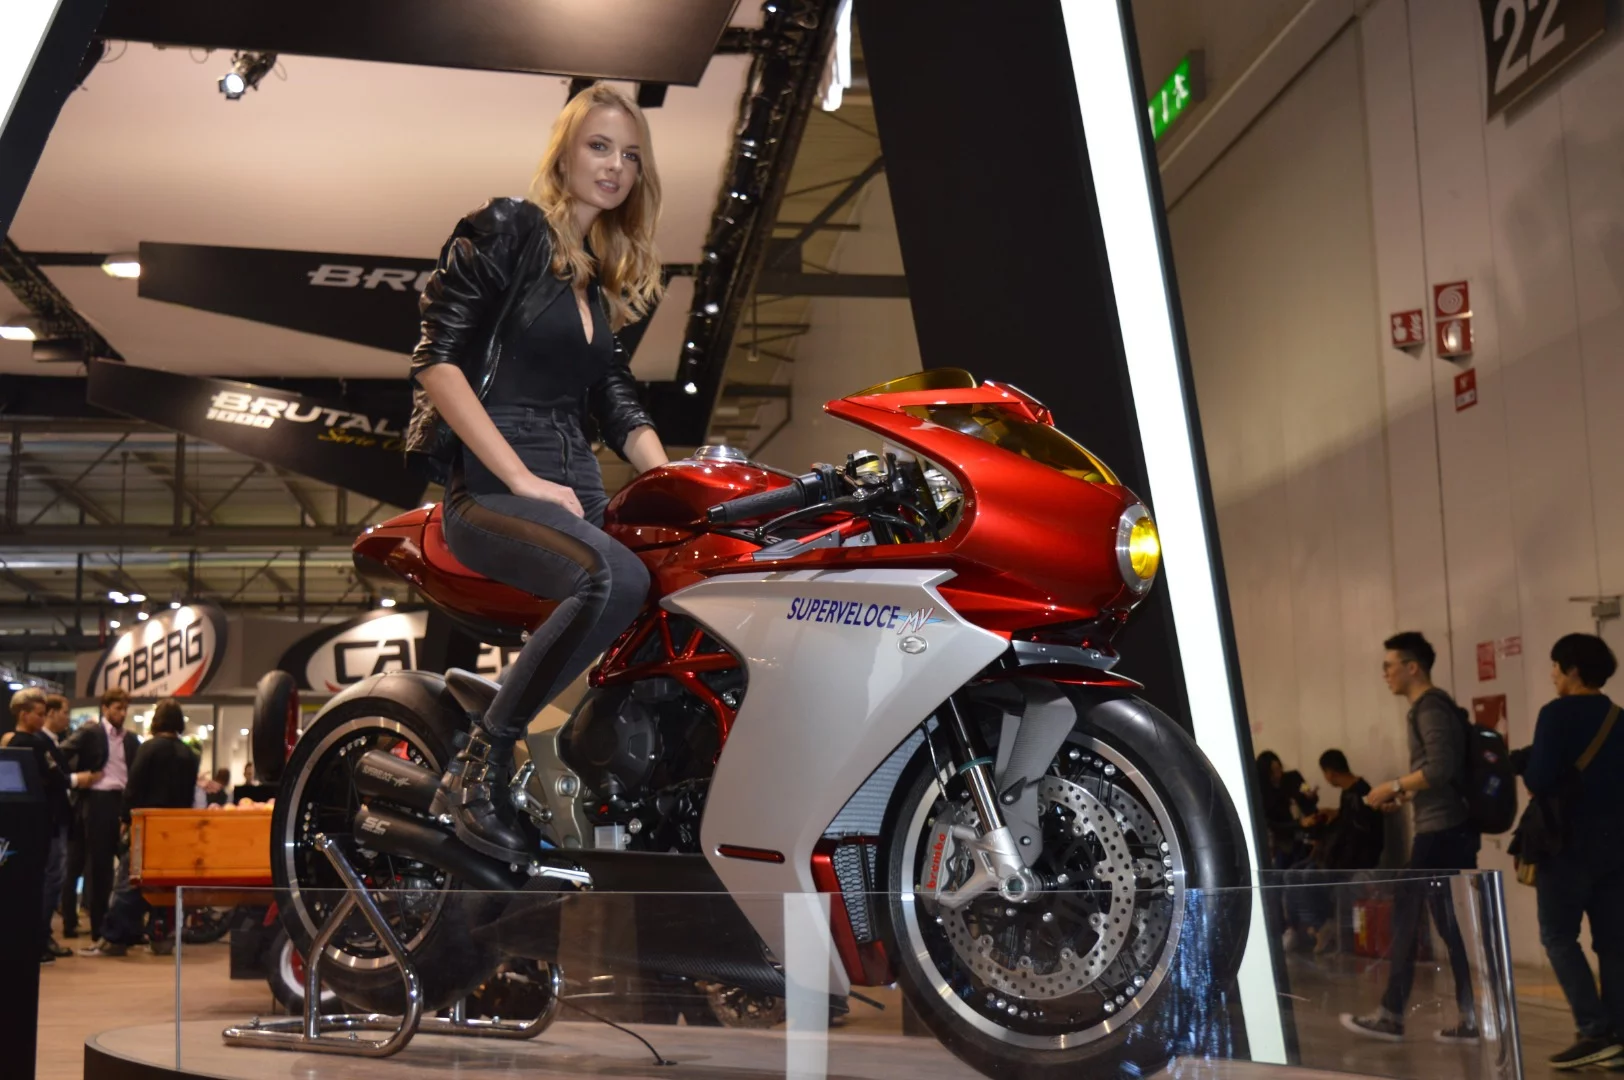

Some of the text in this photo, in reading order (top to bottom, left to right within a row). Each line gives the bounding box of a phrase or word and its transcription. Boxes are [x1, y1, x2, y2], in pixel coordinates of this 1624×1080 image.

[1493, 0, 1565, 95] 22
[206, 407, 275, 429] 1000
[211, 390, 408, 437] BRUTAL
[786, 597, 901, 629] SUPERVELOCE
[104, 618, 203, 693] CABERG
[361, 816, 391, 832] SC
[926, 833, 946, 889] brembo
